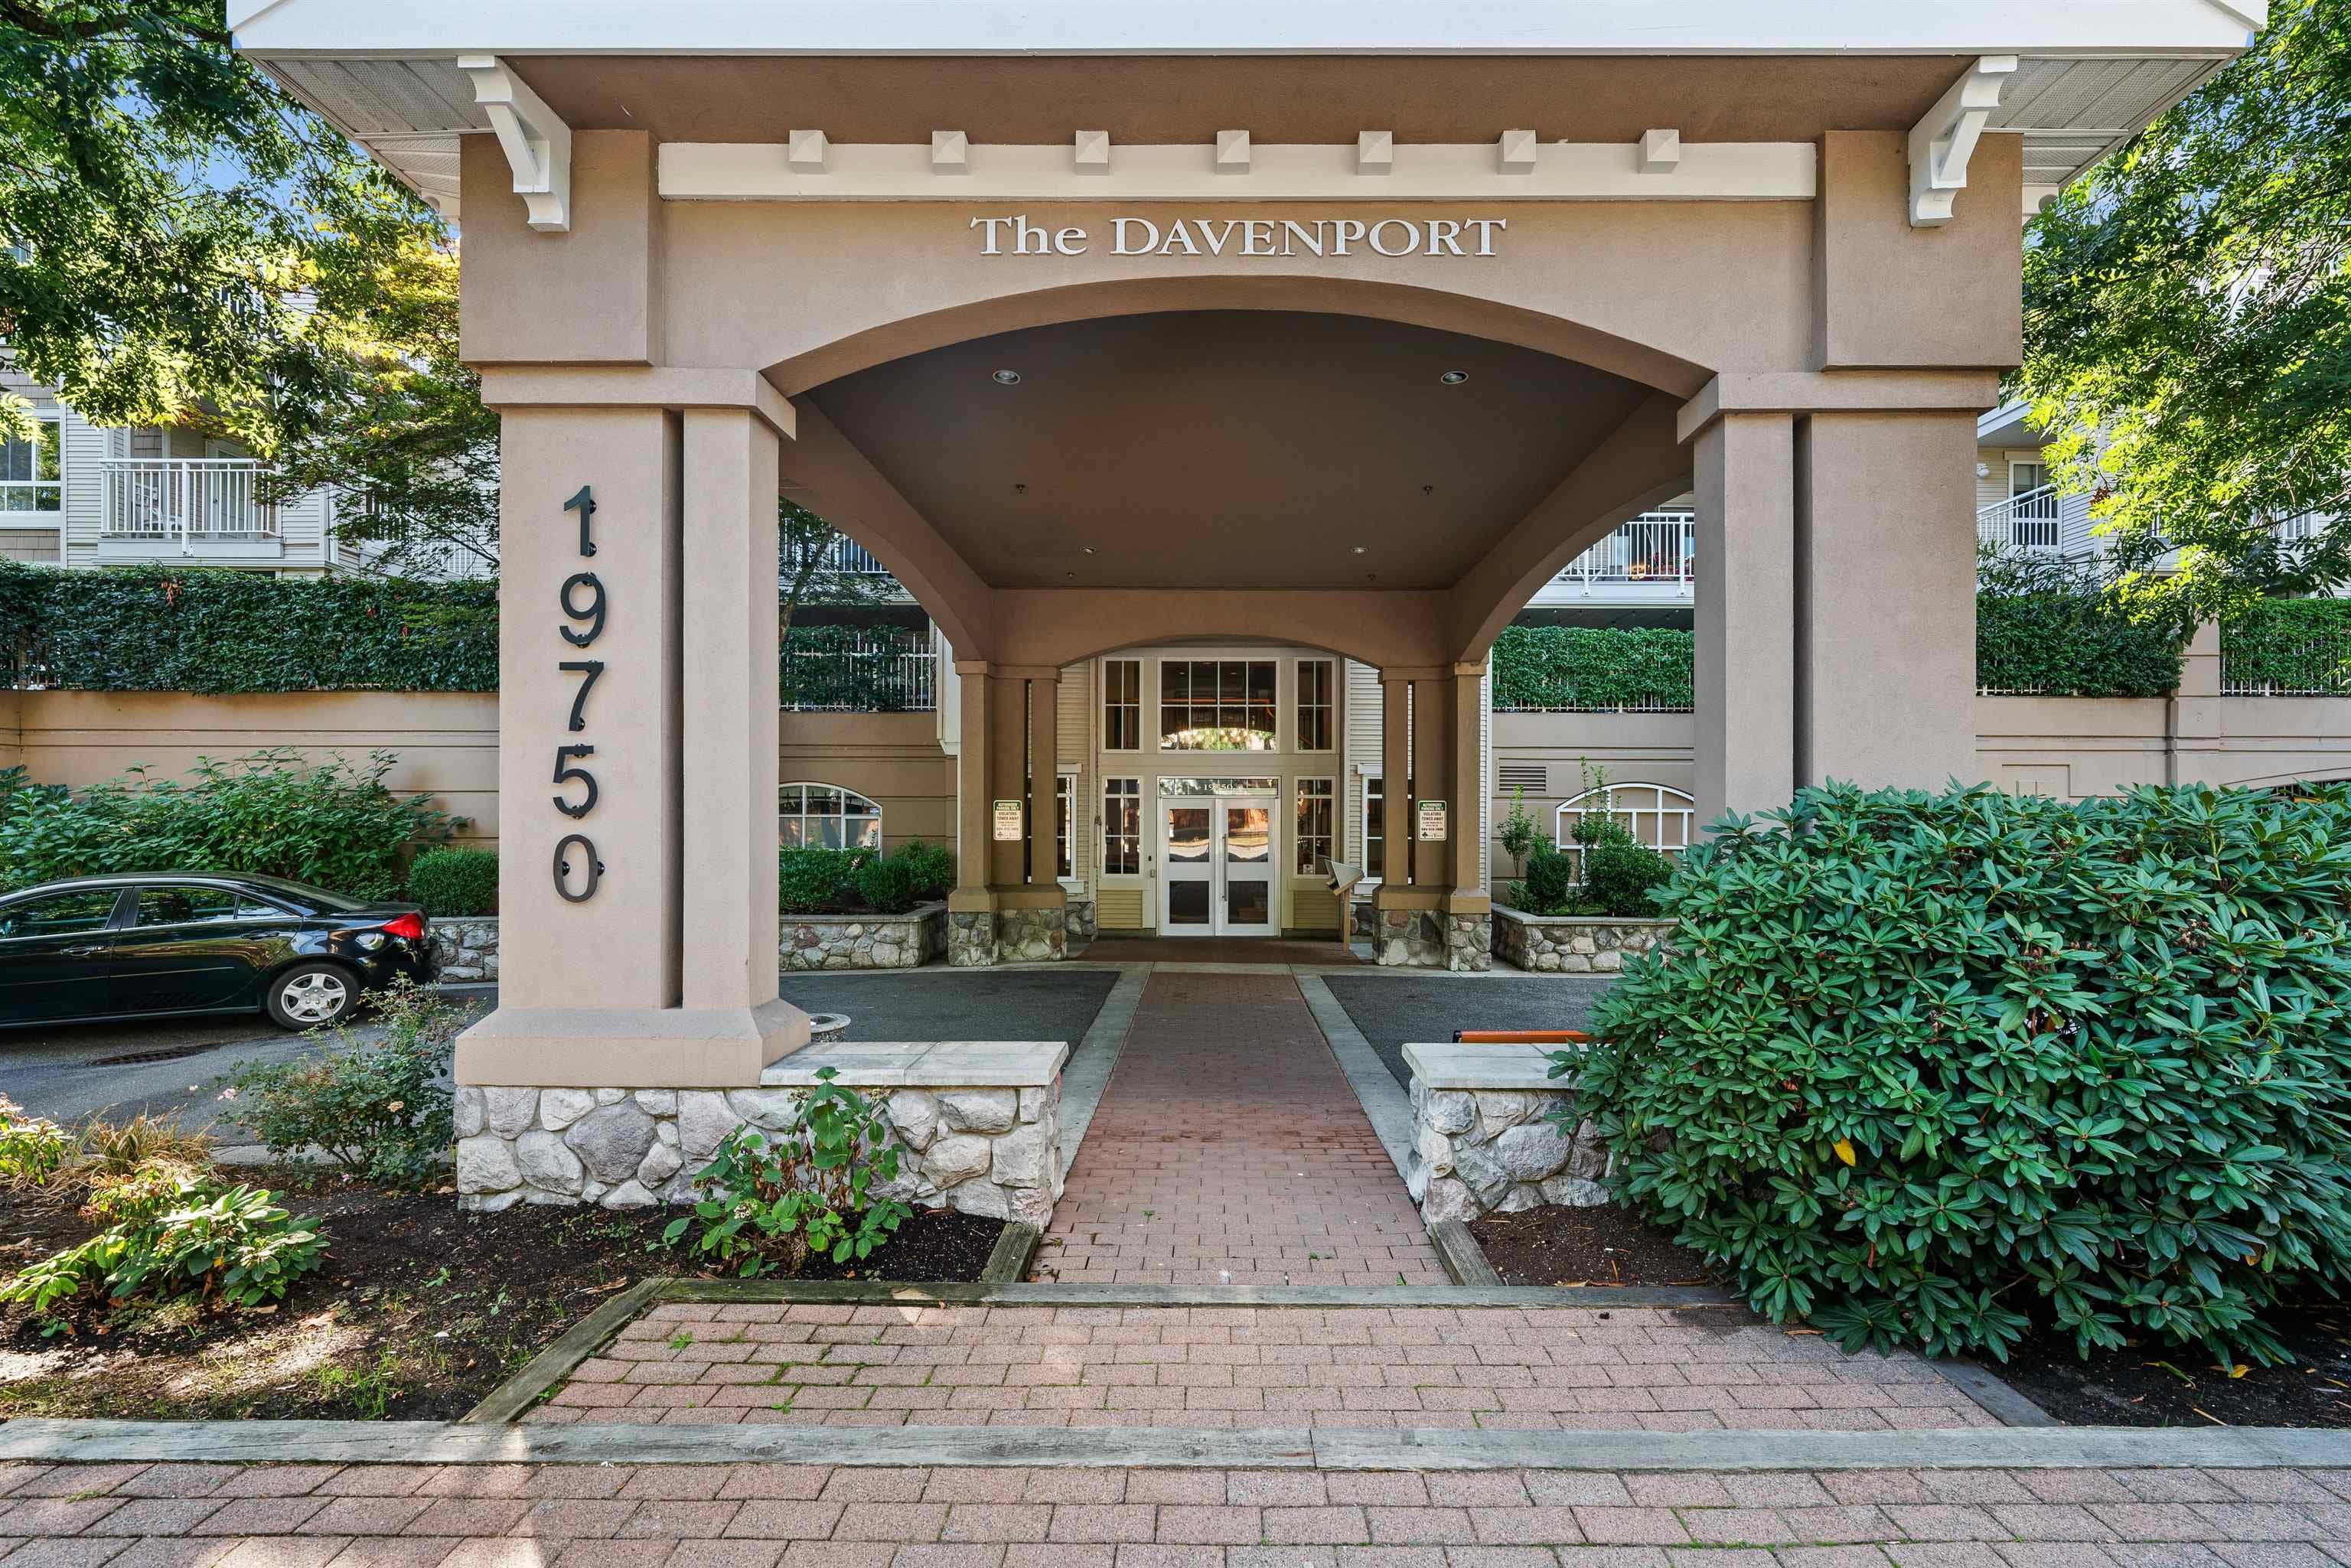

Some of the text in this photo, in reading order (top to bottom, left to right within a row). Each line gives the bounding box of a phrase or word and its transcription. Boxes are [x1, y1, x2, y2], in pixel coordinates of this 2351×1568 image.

[970, 214, 1507, 256] The DAVENPORT
[553, 485, 607, 904] 19750
